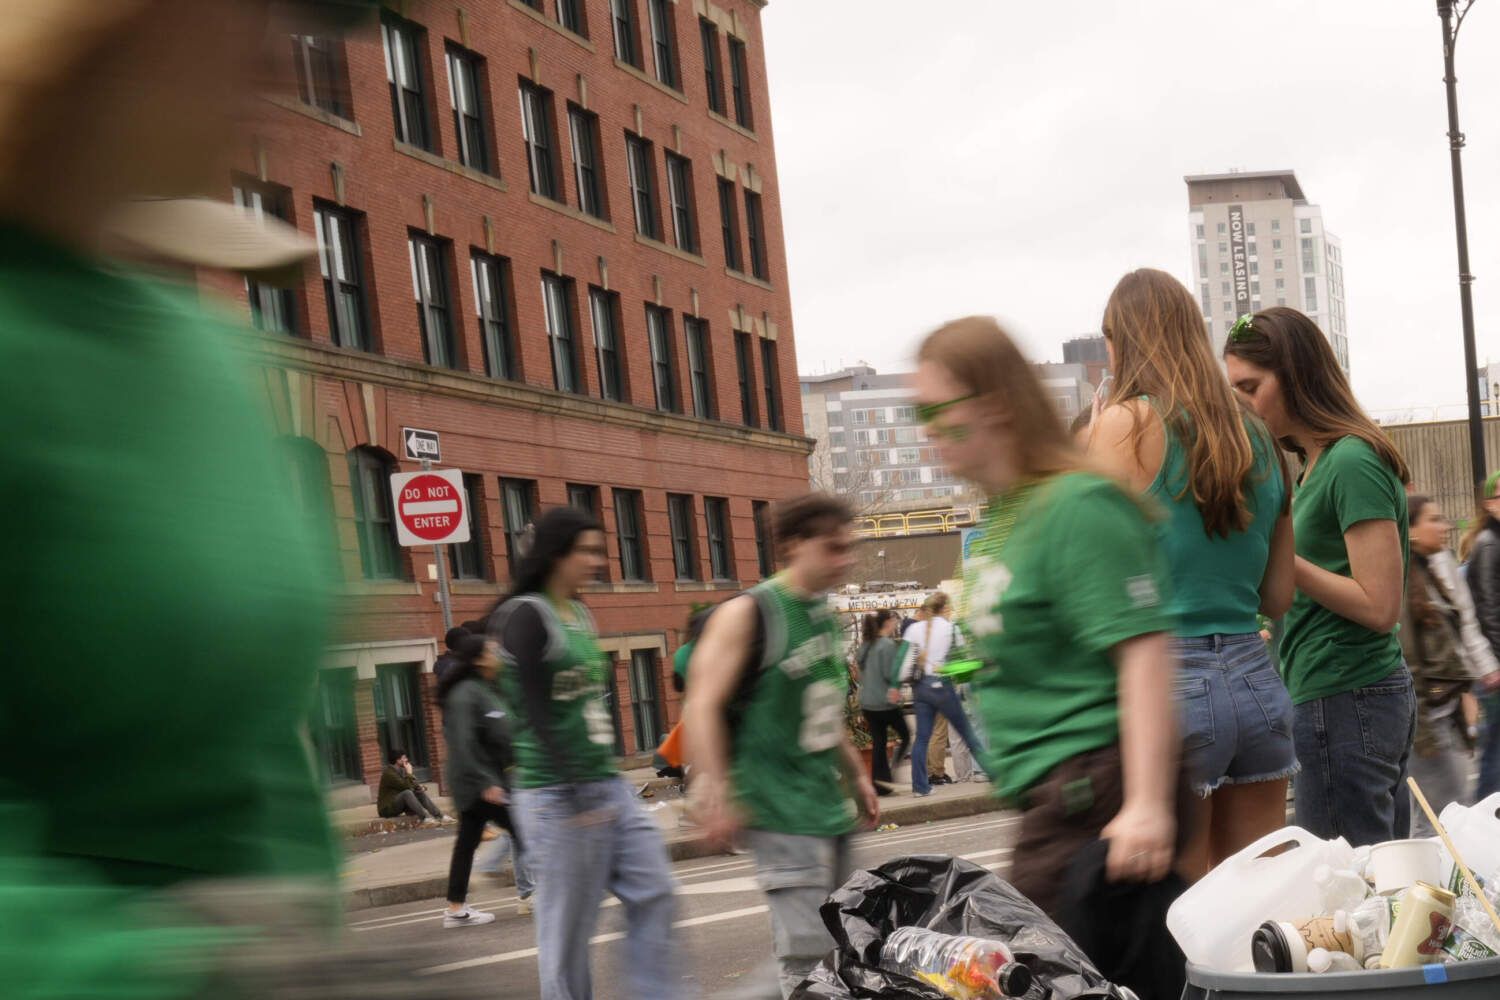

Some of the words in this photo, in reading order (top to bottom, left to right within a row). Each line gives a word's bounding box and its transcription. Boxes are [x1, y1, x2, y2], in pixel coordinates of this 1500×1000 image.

[1231, 211, 1244, 242] NOW
[1233, 246, 1248, 300] LEASING
[416, 439, 425, 452] ONE
[426, 441, 436, 453] WAY
[404, 488, 421, 500] DO
[427, 486, 450, 499] NOT
[413, 516, 451, 529] ENTER
